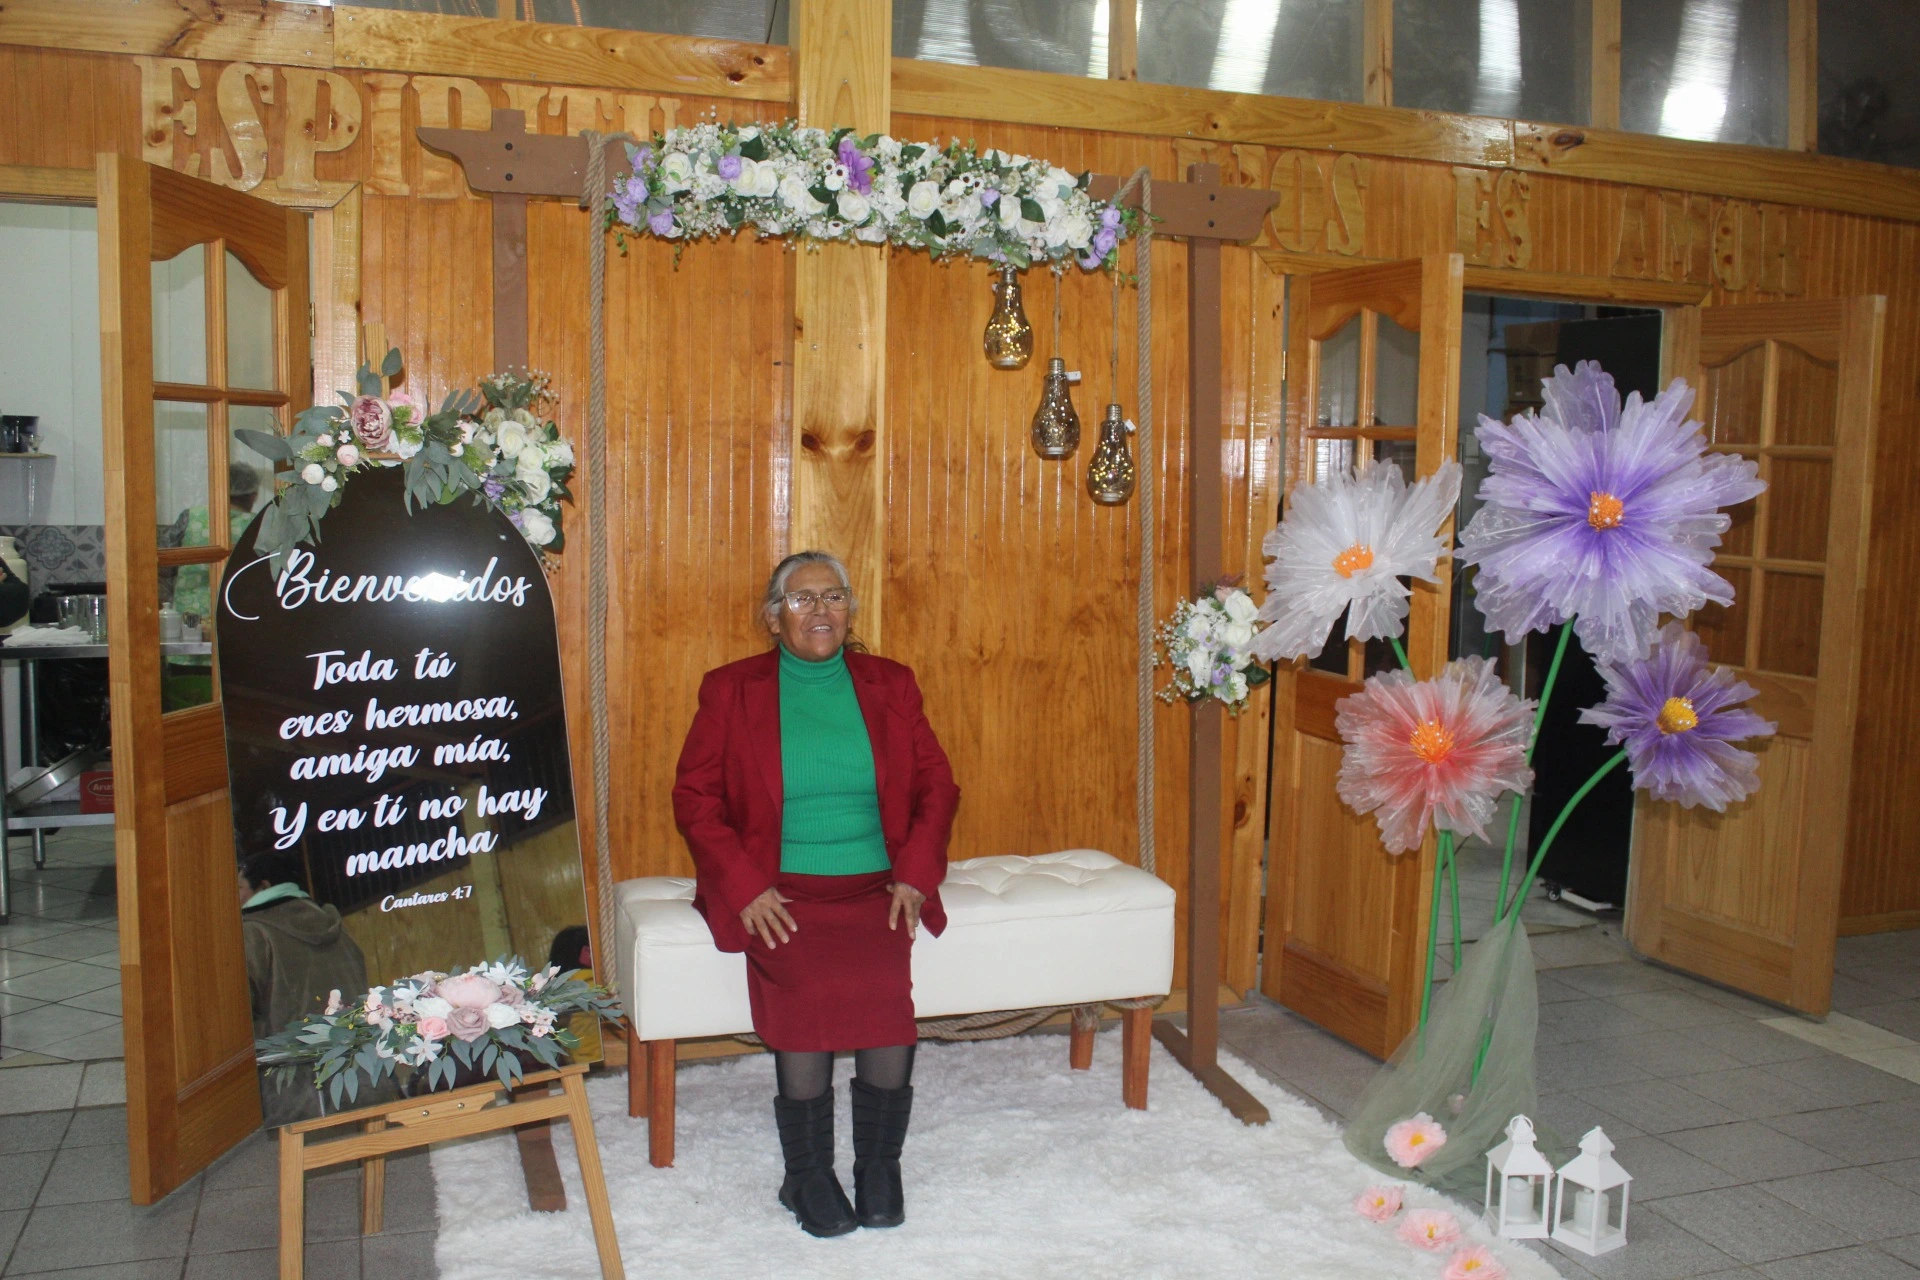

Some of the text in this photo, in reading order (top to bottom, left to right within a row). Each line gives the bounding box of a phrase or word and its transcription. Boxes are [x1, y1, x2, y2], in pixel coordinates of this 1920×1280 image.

[1452, 166, 1533, 270] ES
[225, 549, 532, 620] Bienveidos
[305, 647, 457, 690] Toda tú
[279, 696, 519, 740] eres hermosa,
[289, 734, 511, 784] amiga mía,
[269, 785, 548, 850] Y en tí no hay
[345, 825, 499, 877] mancha
[380, 885, 473, 913] Cantares 4:7
